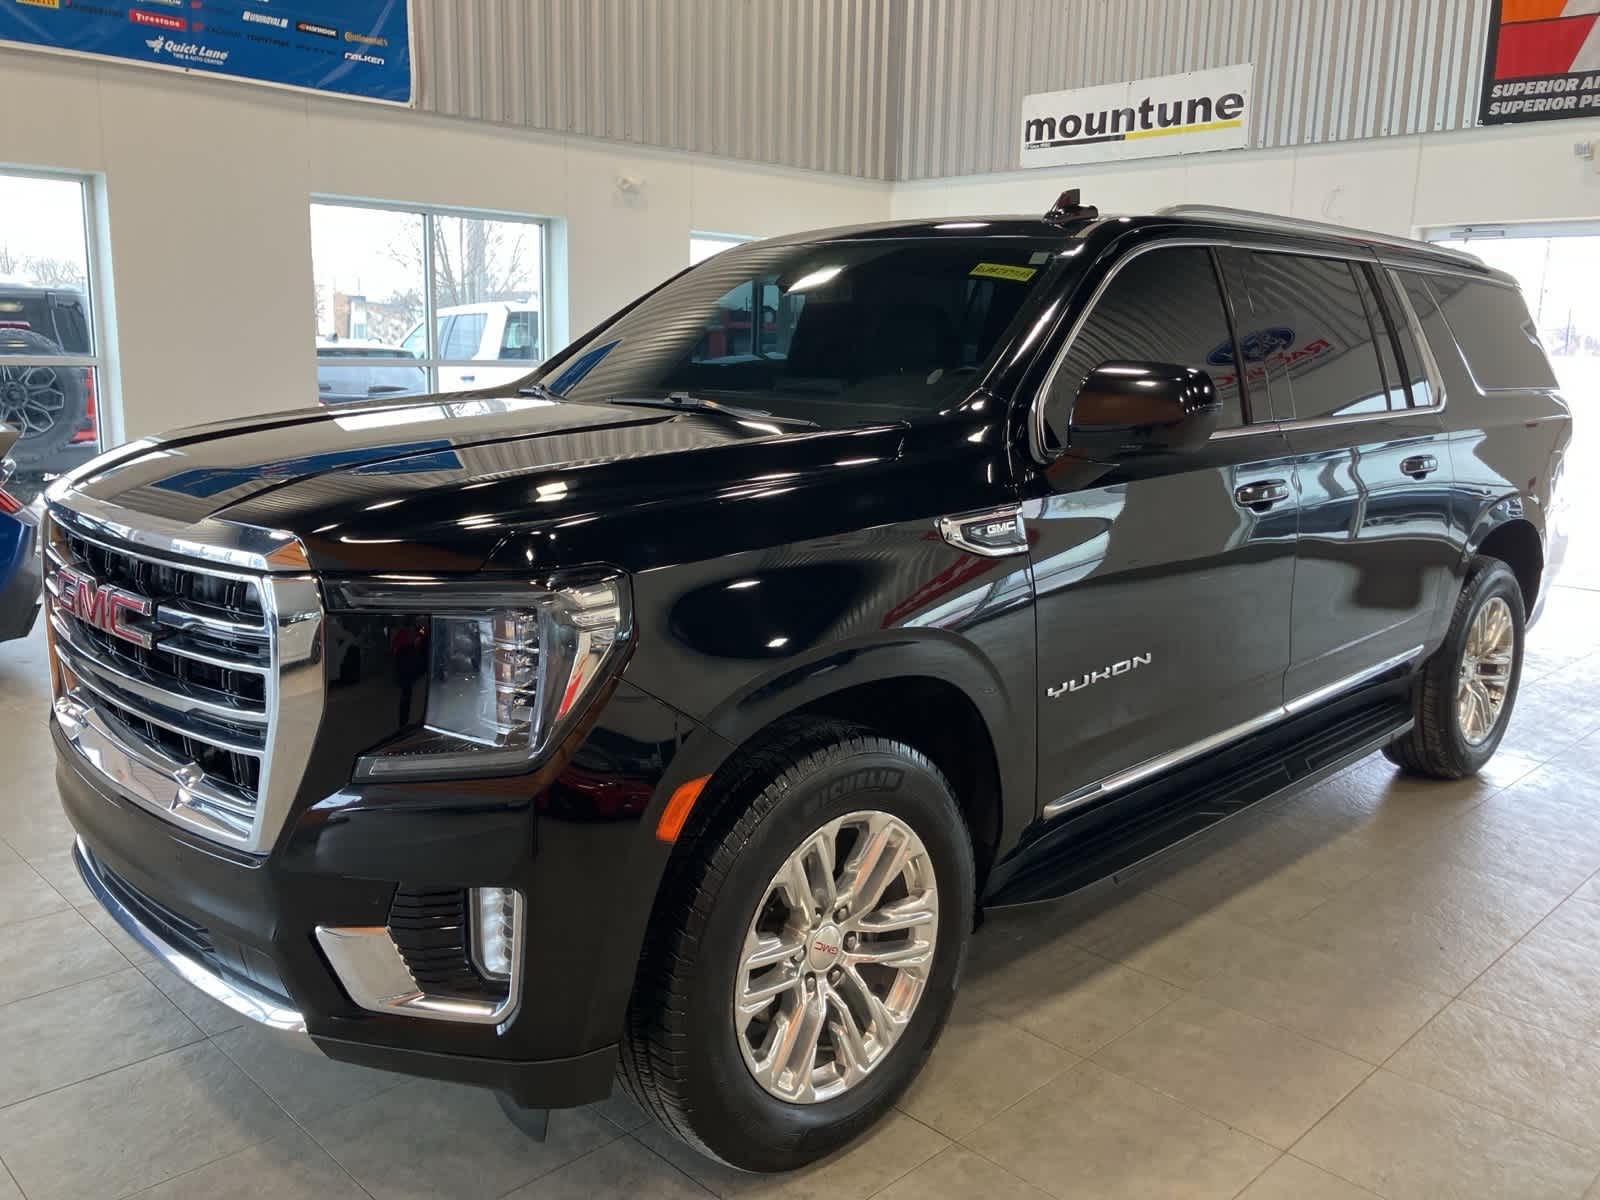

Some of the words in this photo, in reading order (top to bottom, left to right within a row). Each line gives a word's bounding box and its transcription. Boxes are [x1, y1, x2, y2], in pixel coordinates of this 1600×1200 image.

[136, 12, 180, 28] Firestone
[164, 40, 198, 55] Quick
[199, 46, 229, 60] Lane
[345, 52, 384, 65] FALKEN
[1491, 78, 1579, 98] SUPERIOR
[1488, 96, 1578, 115] SUPERIOR
[1024, 92, 1245, 143] mountune
[987, 521, 1016, 534] GMC
[57, 567, 152, 650] GMC
[1047, 653, 1151, 697] YUKON
[815, 941, 839, 956] GMC
